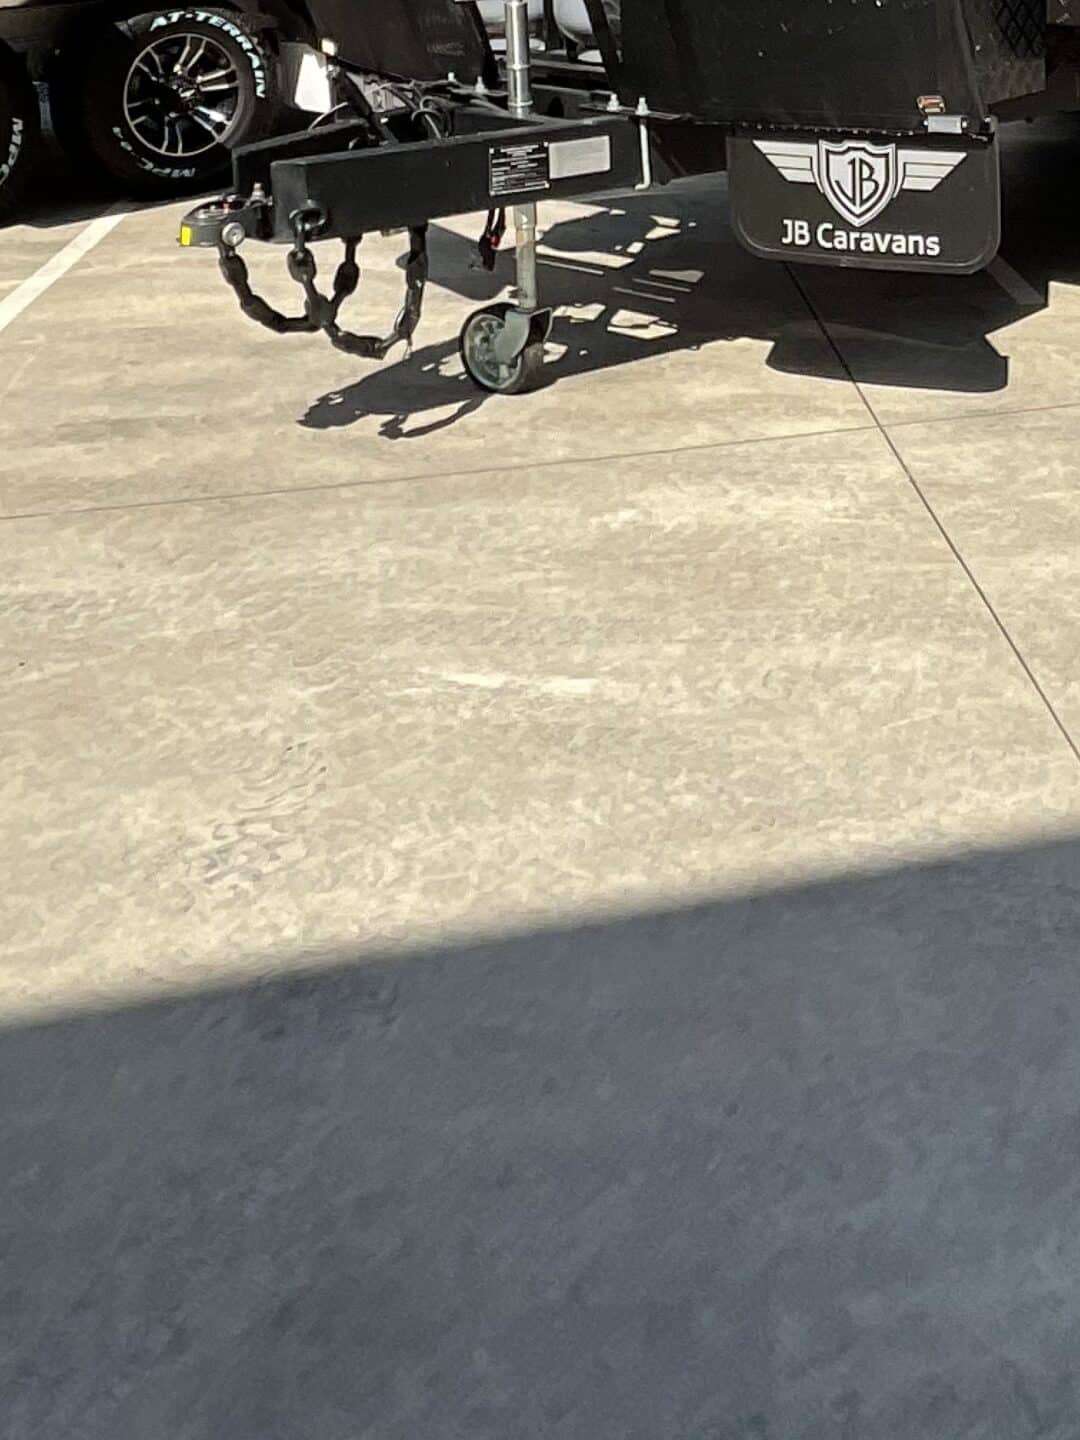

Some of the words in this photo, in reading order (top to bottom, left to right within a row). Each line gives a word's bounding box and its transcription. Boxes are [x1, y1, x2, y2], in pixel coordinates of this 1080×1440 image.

[835, 156, 879, 208] JB
[781, 219, 811, 246] JB
[816, 223, 941, 256] Caravans
